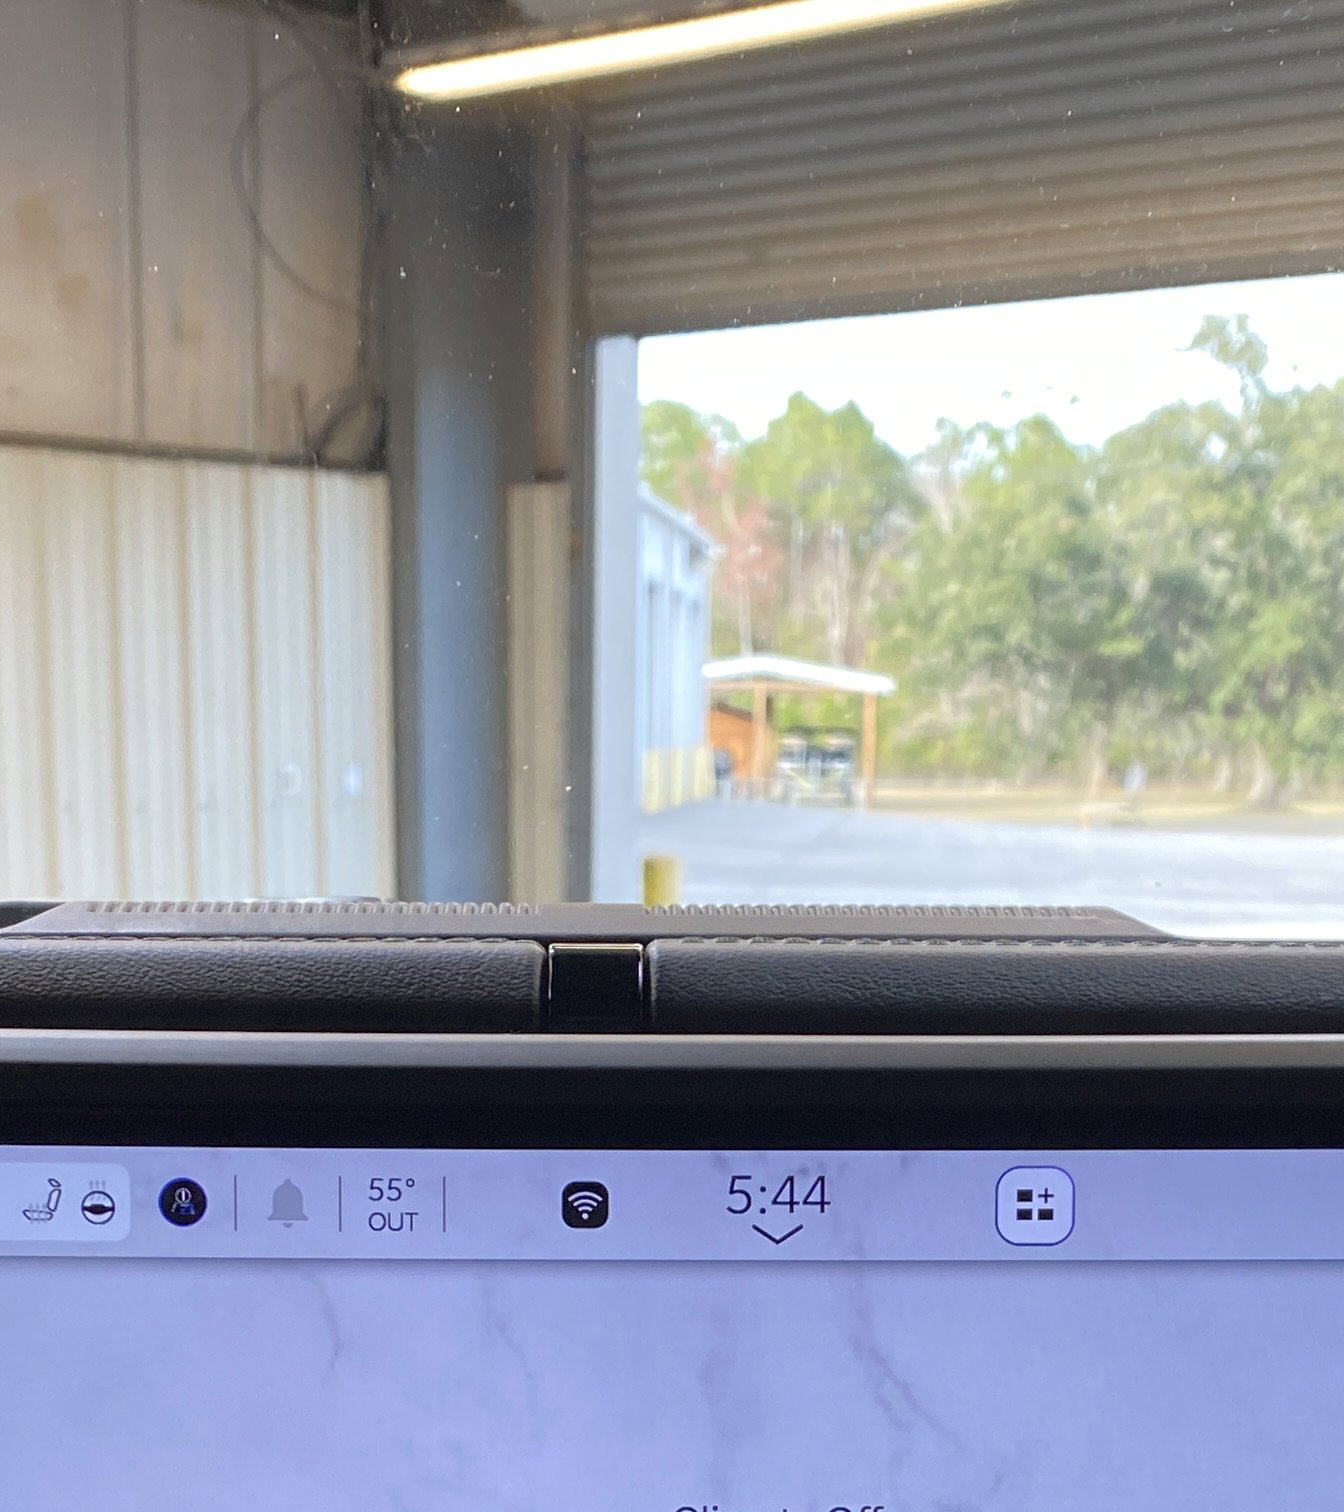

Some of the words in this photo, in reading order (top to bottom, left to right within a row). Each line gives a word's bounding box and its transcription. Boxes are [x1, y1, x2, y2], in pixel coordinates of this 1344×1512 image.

[369, 1178, 416, 1201] 55°
[726, 1175, 831, 1216] 5:44
[369, 1212, 418, 1232] OUT
